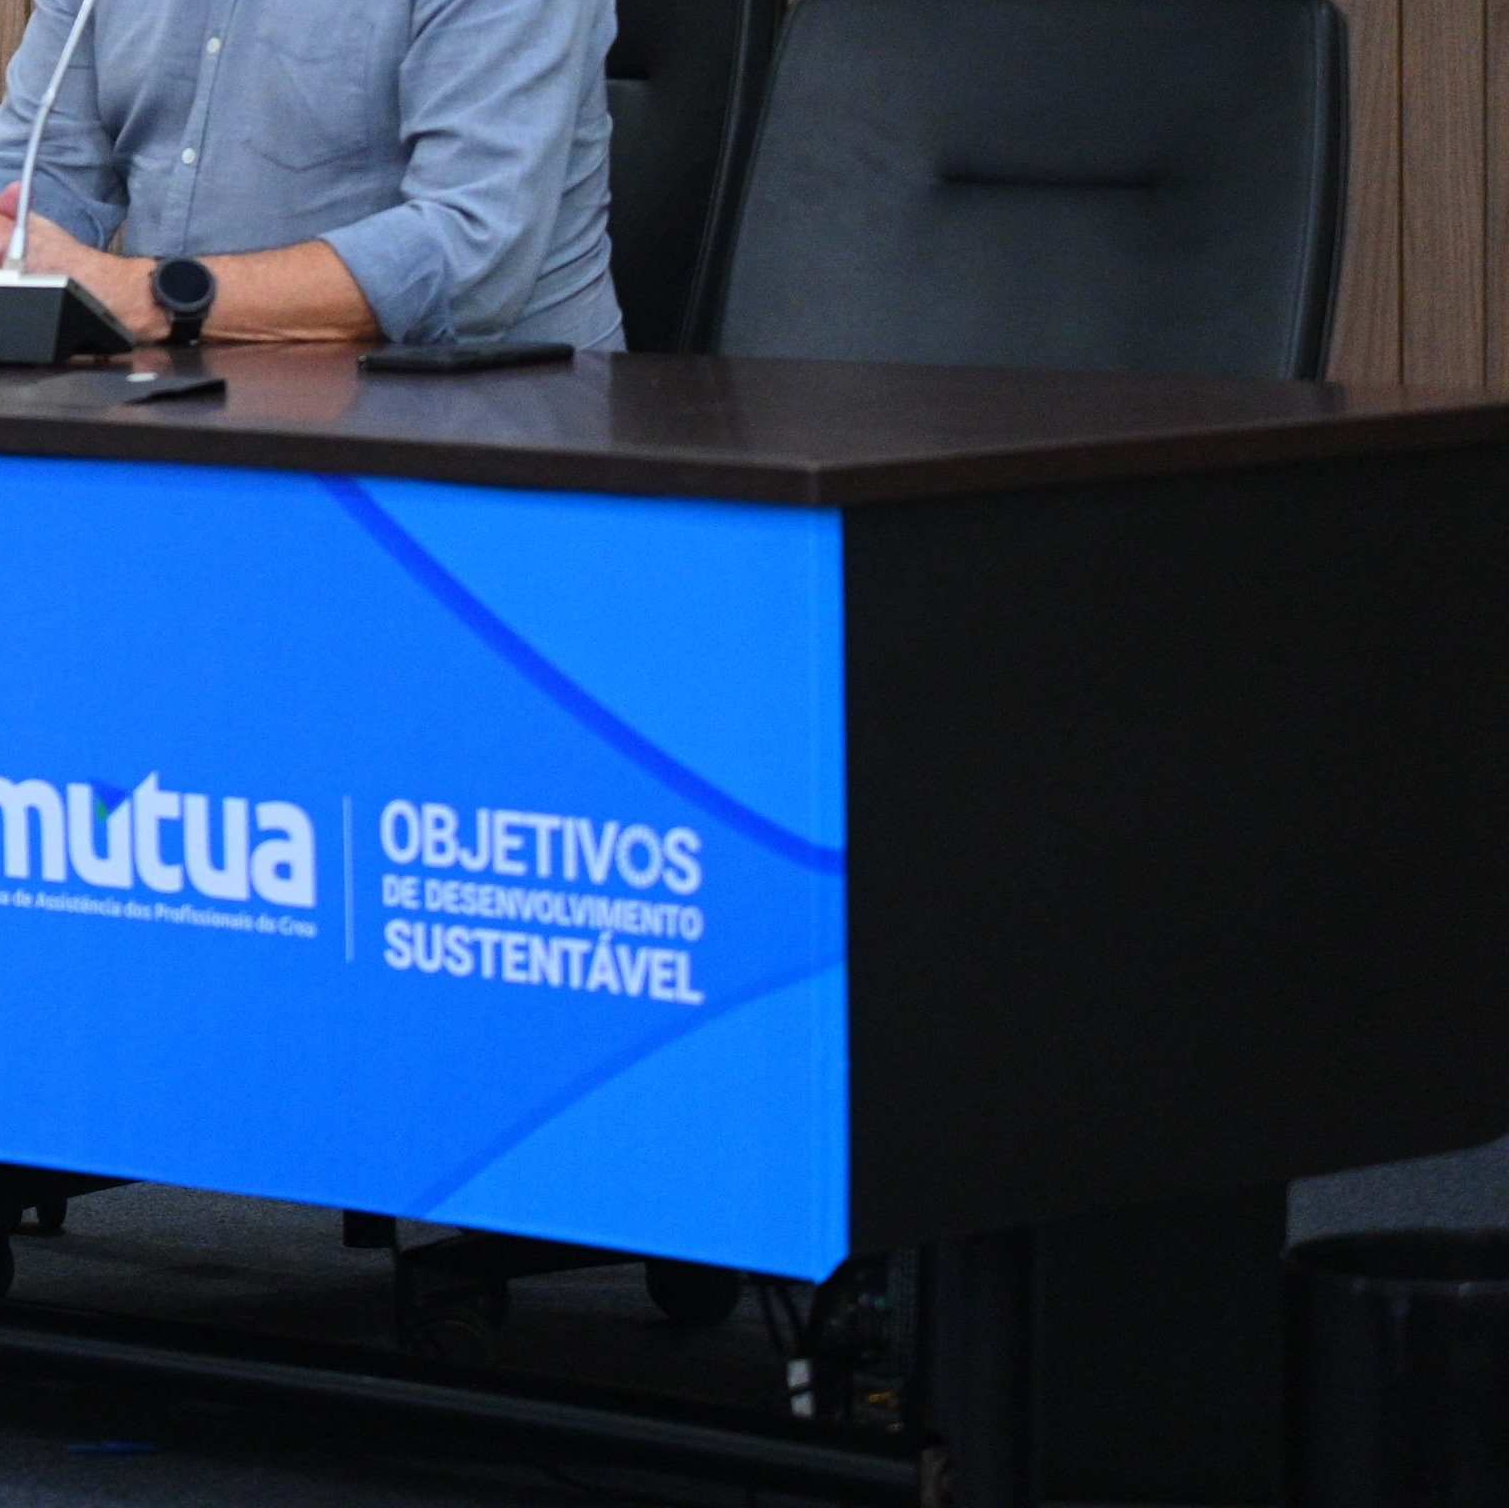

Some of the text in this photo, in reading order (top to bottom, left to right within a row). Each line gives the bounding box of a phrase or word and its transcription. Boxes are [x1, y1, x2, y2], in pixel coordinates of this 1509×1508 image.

[380, 798, 702, 895] OBJETIVOS
[12, 888, 32, 907] de
[35, 891, 122, 918] Assistência
[123, 898, 151, 920] dos
[154, 902, 253, 931] Profissionais
[382, 873, 705, 941] DE DESENVOLVIMENTO
[383, 918, 705, 1006] SUSTENTÁVEL
